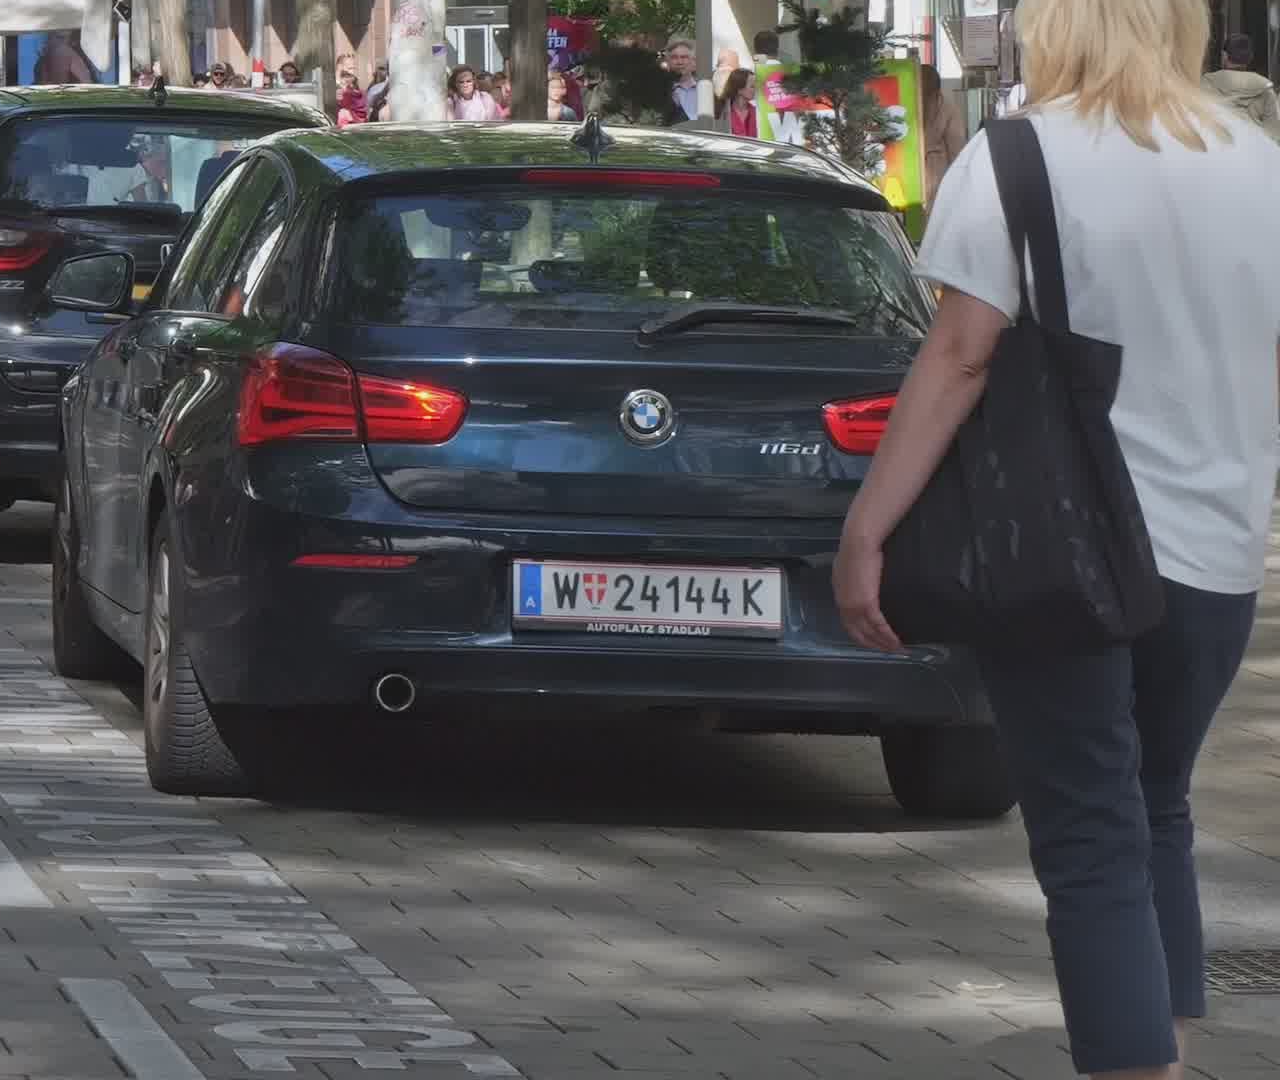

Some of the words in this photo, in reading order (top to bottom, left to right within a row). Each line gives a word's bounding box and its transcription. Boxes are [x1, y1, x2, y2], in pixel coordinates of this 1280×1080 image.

[759, 442, 821, 456] 116d
[553, 571, 580, 610] W
[525, 596, 536, 608] A
[587, 623, 654, 634] AUTOPLATZ
[658, 625, 710, 636] STADLAU
